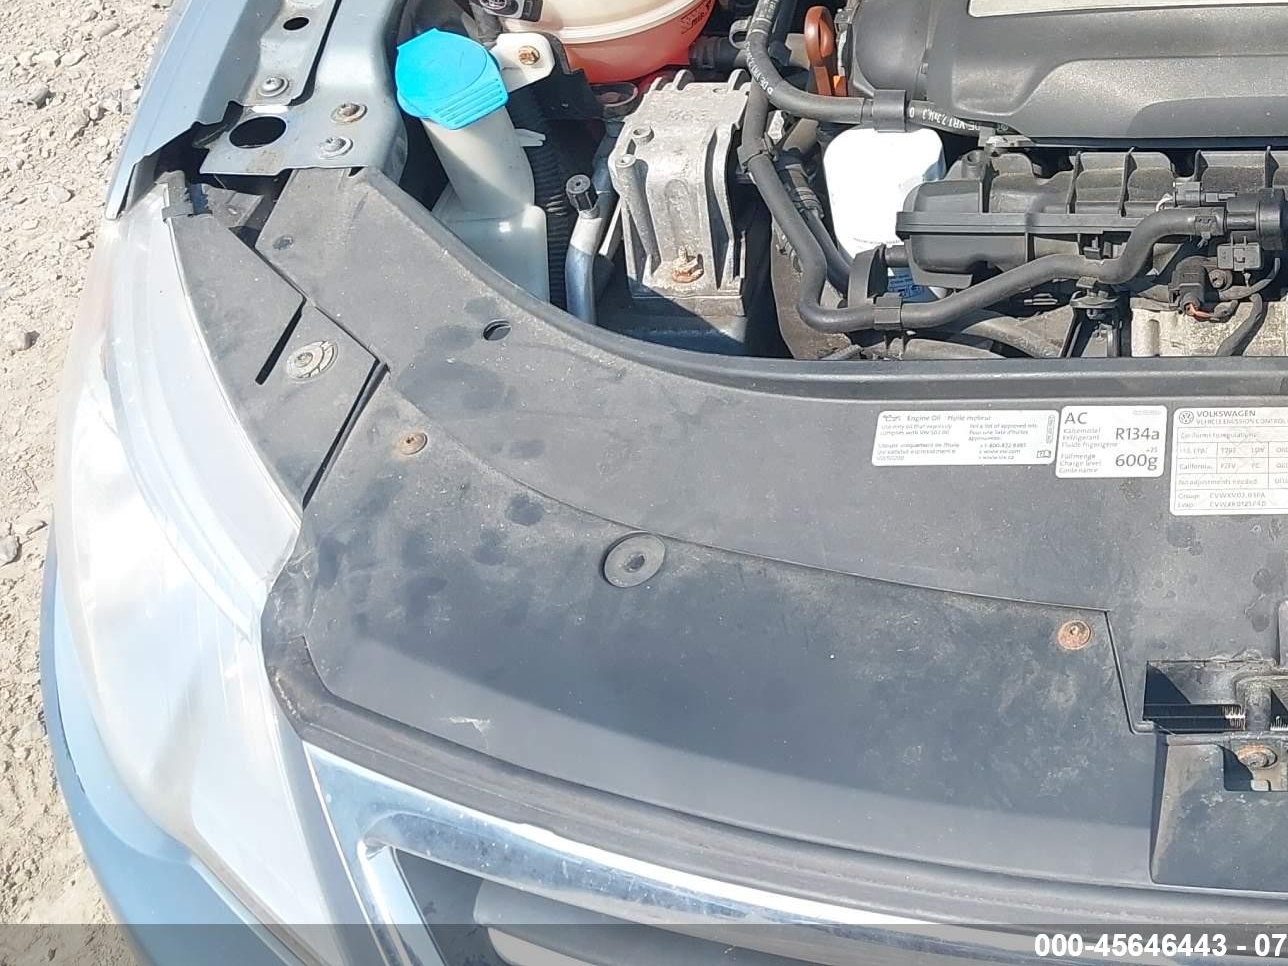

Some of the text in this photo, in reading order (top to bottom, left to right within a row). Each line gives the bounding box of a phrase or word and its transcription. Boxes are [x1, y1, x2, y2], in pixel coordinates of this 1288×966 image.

[907, 415, 930, 423] Engine
[1064, 411, 1089, 425] AC
[1196, 409, 1256, 418] VOLKSWAGEN
[1115, 427, 1160, 441] R134a
[1115, 453, 1159, 471] 600g
